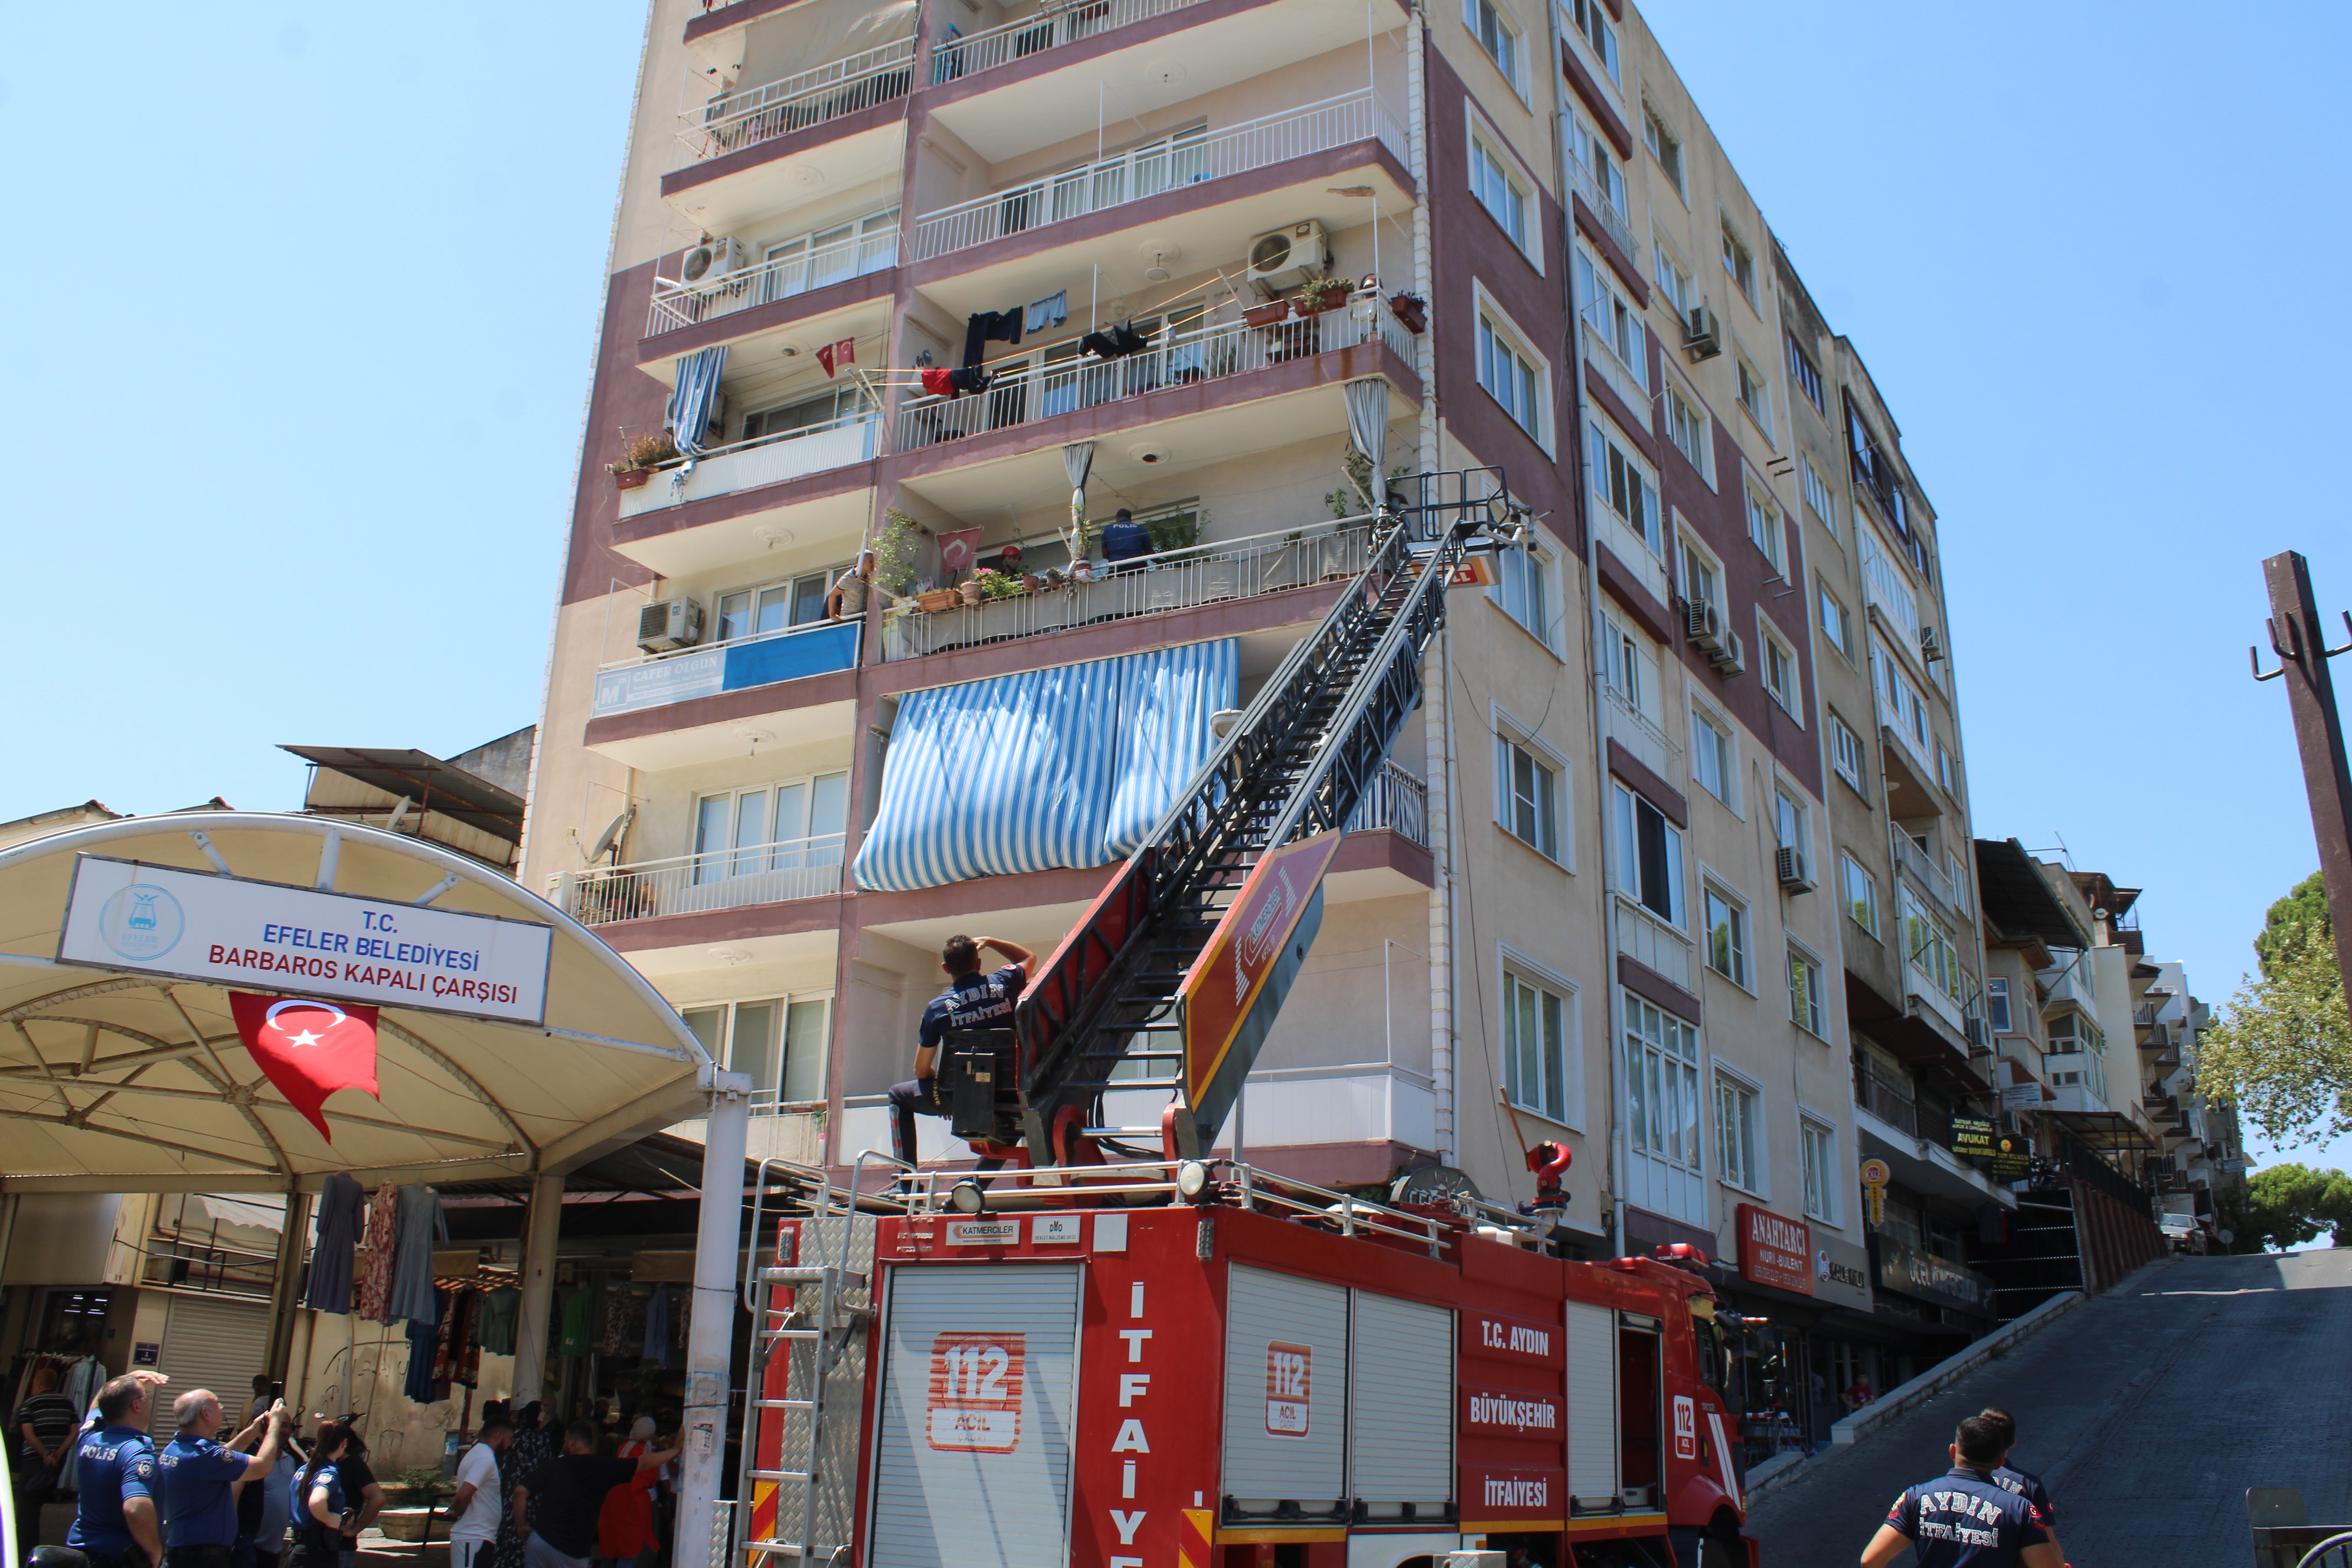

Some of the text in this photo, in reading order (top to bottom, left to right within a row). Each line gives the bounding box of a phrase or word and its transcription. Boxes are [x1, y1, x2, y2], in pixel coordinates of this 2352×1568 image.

[633, 656, 718, 683] CAFER OLGUN
[362, 911, 398, 933] T.C.
[263, 923, 479, 971] EFELER BELEDİYESİ
[208, 945, 518, 1004] BARBAROS KAPALI ÇARŞISI
[945, 984, 1004, 1014] AYDIN
[950, 998, 1012, 1027] İTFAİYESİ
[1957, 1132, 1990, 1145] AVUKAT
[962, 1224, 1013, 1235] KATMERCİLER
[1050, 1220, 1063, 1233] DMO
[1752, 1211, 1807, 1256] ANAHTARCI
[1482, 1321, 1549, 1356] T.C. AYDIN
[945, 1345, 1009, 1400] 112
[1273, 1351, 1304, 1397] 112
[1279, 1404, 1296, 1420] ACİL
[1471, 1392, 1555, 1432] BÜYÜKŞEHİR
[1677, 1403, 1692, 1432] 112
[1485, 1475, 1547, 1507] İTFAİYESİ
[1920, 1492, 2002, 1525] AYDIN
[1919, 1517, 1999, 1547] İTFAİYESİ
